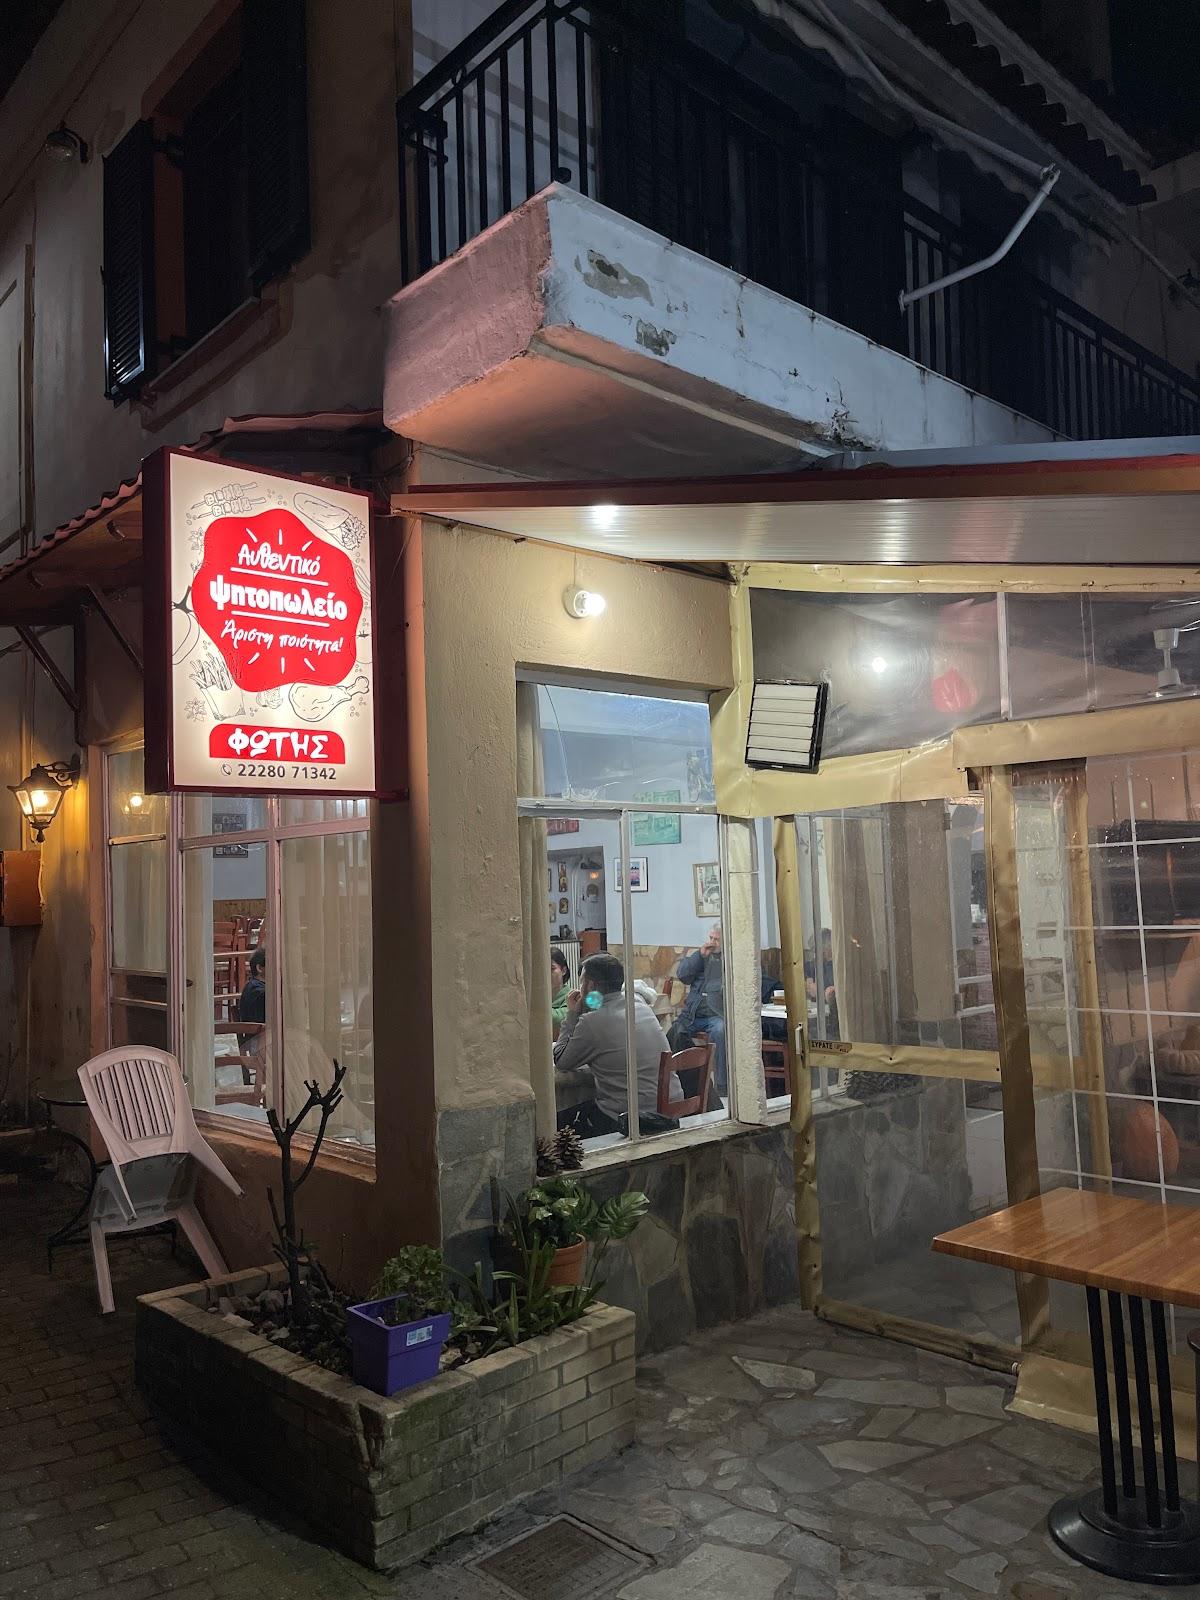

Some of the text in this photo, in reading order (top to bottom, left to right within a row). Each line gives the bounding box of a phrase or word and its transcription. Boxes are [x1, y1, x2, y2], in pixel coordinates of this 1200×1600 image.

[238, 542, 321, 576] Αυθεντικό
[220, 619, 344, 656] Άριστη ποιότητα!
[227, 727, 329, 758] ΦΩΤΗΣ
[238, 764, 337, 780] 22280 71342
